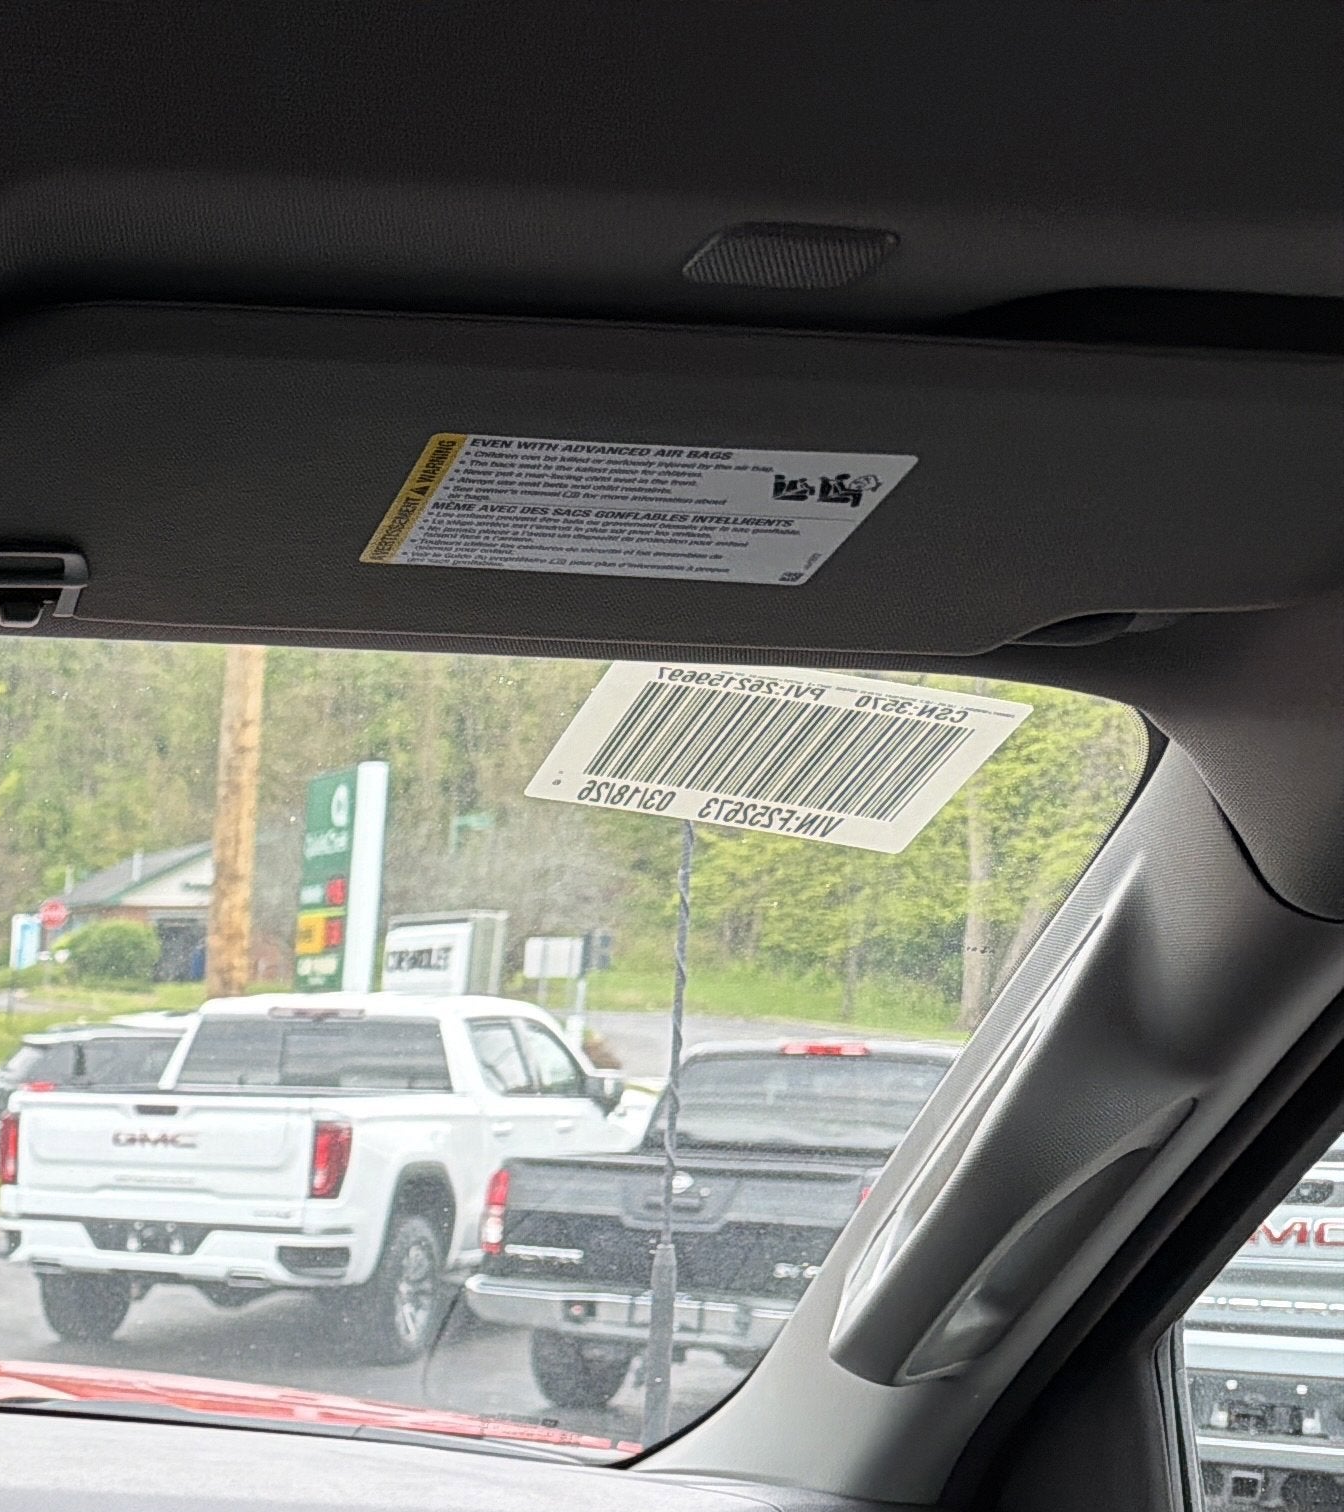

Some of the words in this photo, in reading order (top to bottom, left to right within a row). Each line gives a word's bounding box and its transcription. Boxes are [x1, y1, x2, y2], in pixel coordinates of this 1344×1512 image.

[471, 439, 512, 448] EVEN
[517, 441, 559, 451] WITH
[562, 444, 650, 456] ADVANCED
[654, 449, 683, 458] AIR
[686, 450, 733, 460] BAGS
[431, 501, 476, 512] MÊME
[479, 504, 516, 513] AVEC
[520, 506, 549, 515] DES
[553, 508, 592, 518] SACS
[595, 510, 690, 523] GONFLABLES
[691, 514, 794, 527] INTELLIGENTS
[112, 1132, 198, 1148] GMC
[1247, 1219, 1344, 1247] MC
